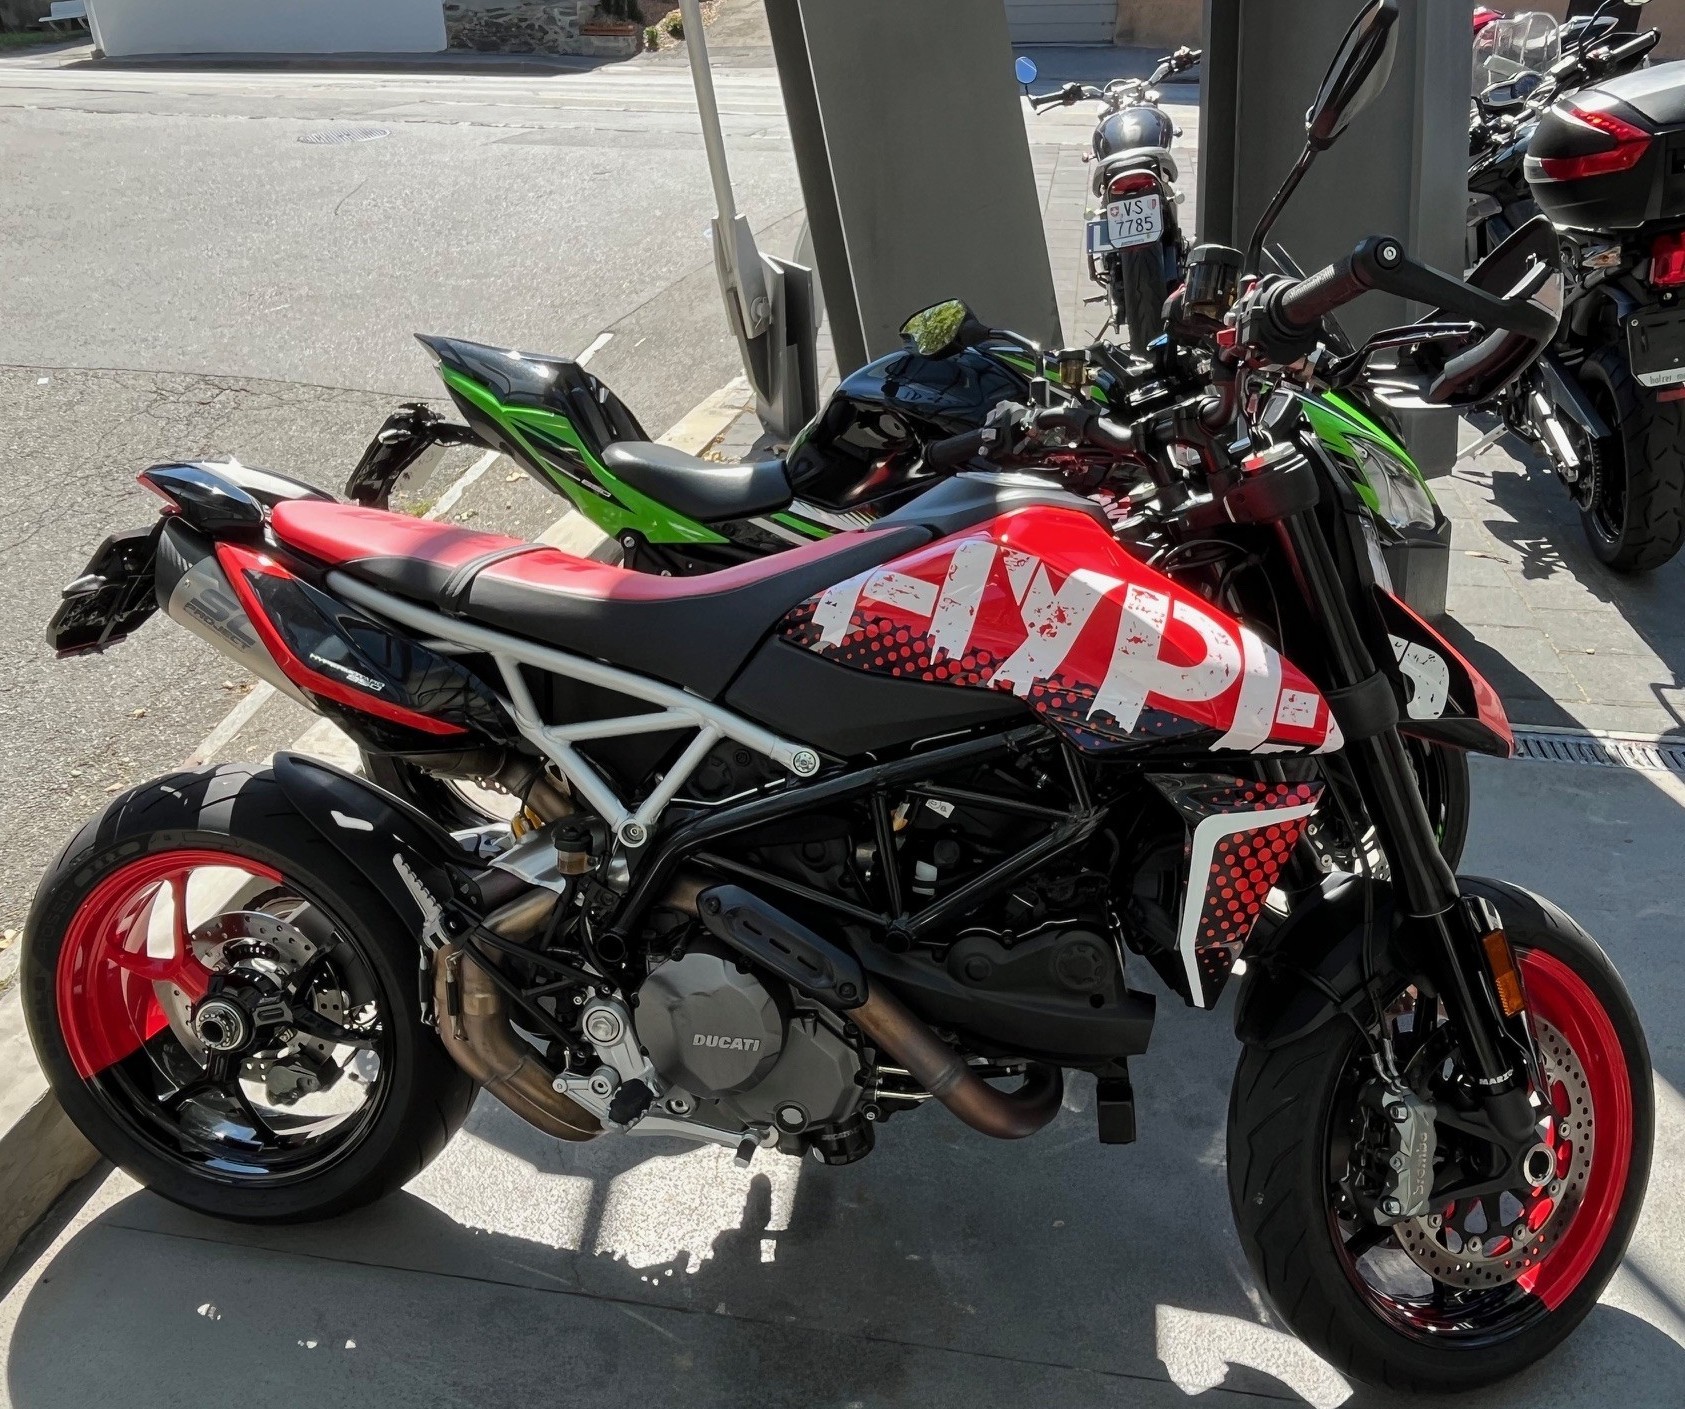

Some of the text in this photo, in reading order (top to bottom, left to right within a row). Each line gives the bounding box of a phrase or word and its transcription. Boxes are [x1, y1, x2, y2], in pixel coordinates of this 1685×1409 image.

[1123, 200, 1144, 217] VS
[1116, 216, 1154, 236] 7785
[183, 598, 249, 651] PROJECT
[692, 1034, 760, 1052] DUCATI
[1412, 1132, 1428, 1195] brembo
